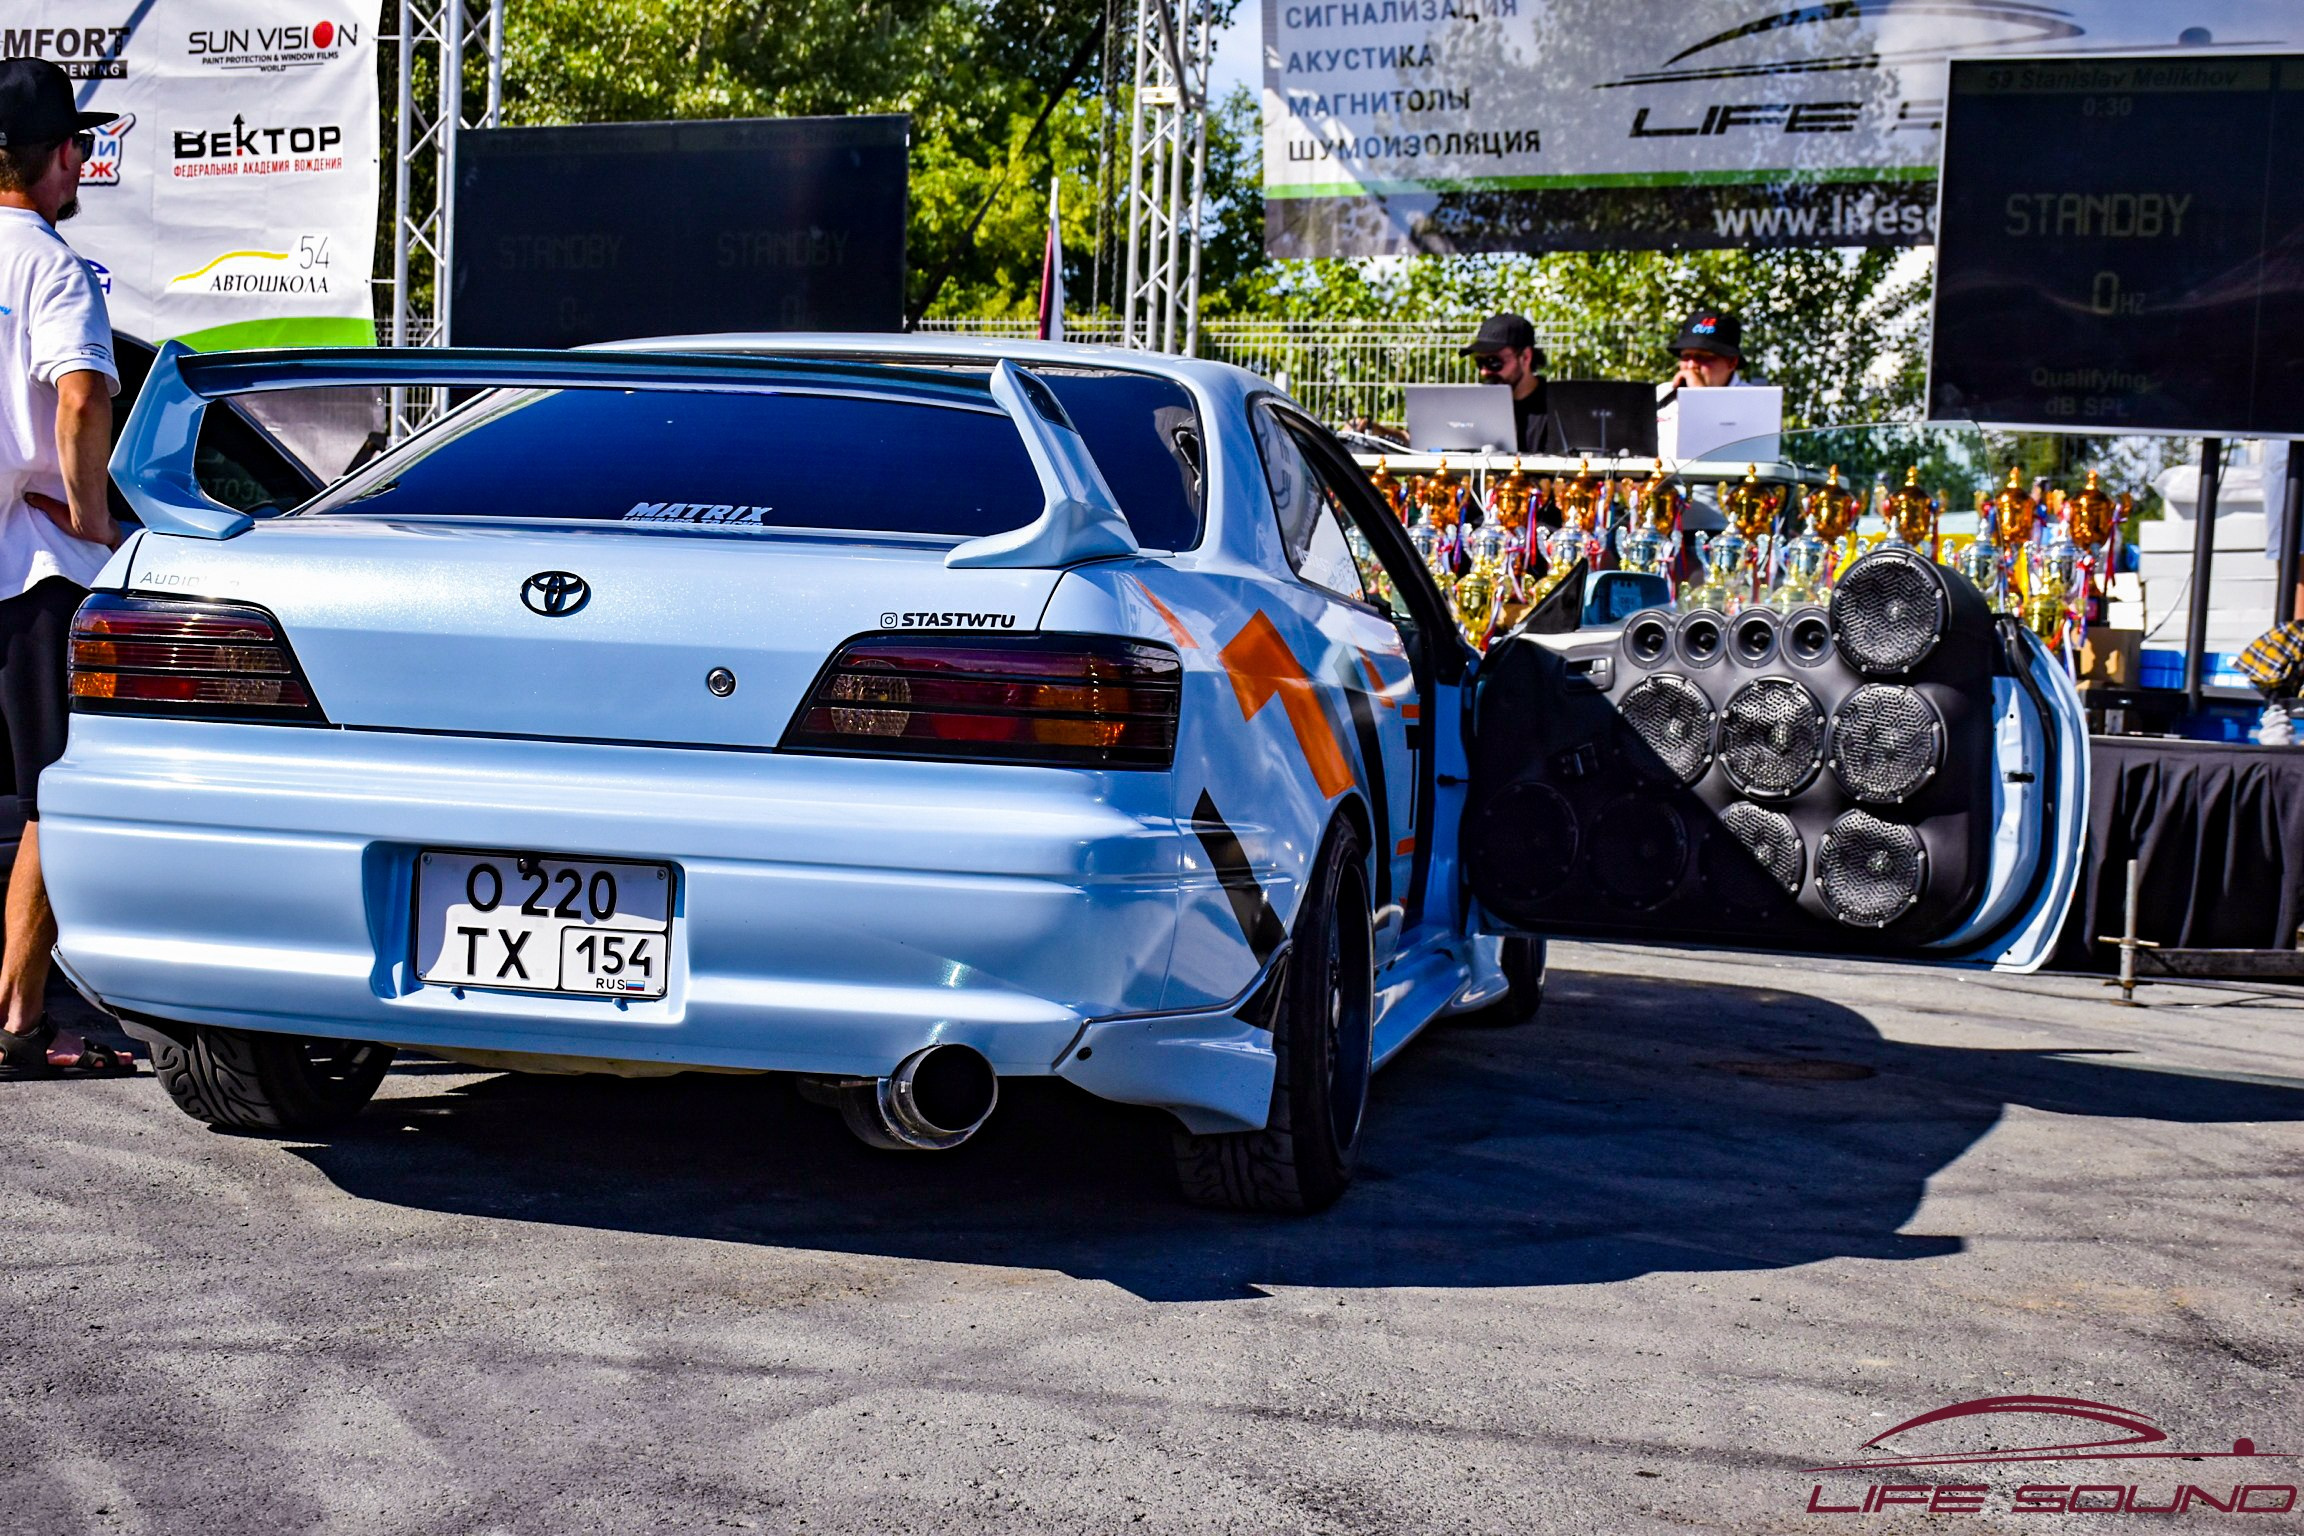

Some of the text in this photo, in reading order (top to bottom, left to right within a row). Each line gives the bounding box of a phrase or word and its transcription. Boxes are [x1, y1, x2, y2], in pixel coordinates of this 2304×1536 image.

[1286, 0, 1518, 28] СИГНАЛИЗАЦИЯ
[0, 28, 130, 58] MFORT
[188, 29, 249, 54] SUN
[202, 51, 339, 65] PAINT PROTECTION & WINDOW FILMS
[260, 64, 286, 73] WORLD
[1286, 45, 1435, 74] АКУСТИКА
[2020, 68, 2125, 89] Stanislav
[2131, 66, 2239, 87] Melikhov
[1287, 88, 1471, 118] МАГНИТОЛЫ
[1629, 101, 1863, 138] LIFE
[1288, 130, 1542, 162] ШУМОИЗОЛЯЦИЯ
[173, 157, 342, 177] ФЕДЕРАЛЬНАЯ АКАДЕМИЯ ВОЖДЕНИЯ
[2004, 193, 2192, 237] STANDBY
[300, 235, 330, 270] 54
[499, 233, 623, 270] STANDBY
[717, 229, 851, 268] STANDBY
[209, 274, 329, 294] АВТОШКОЛА
[2031, 366, 2148, 392] Qualifying
[2045, 398, 2076, 416] dB
[624, 502, 773, 521] MATRIX
[901, 612, 1016, 629] STASTWTU
[520, 868, 617, 921] 220
[576, 935, 652, 977] 154
[596, 977, 625, 991] RUS
